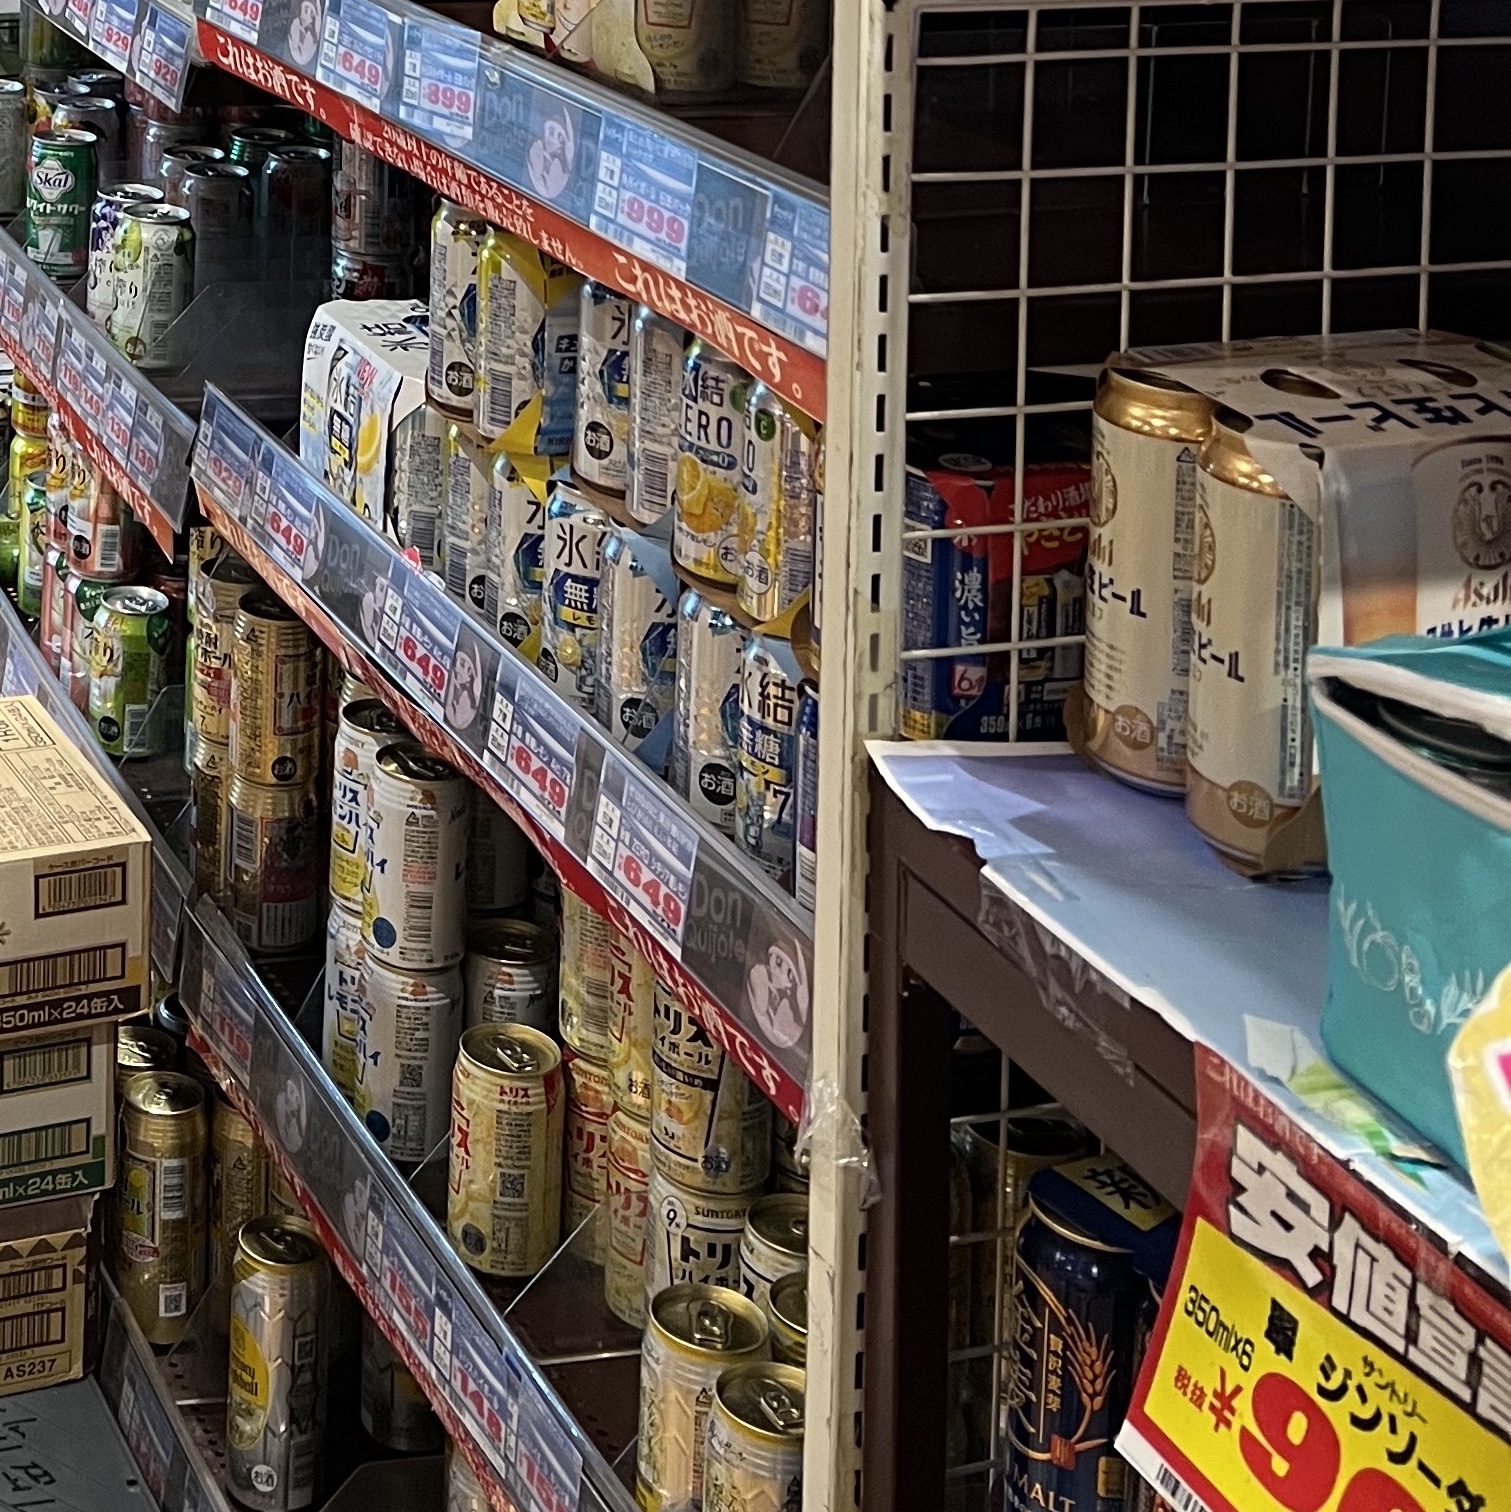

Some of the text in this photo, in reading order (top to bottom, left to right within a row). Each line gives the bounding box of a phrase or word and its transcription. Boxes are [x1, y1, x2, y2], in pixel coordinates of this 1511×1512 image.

[215, 32, 329, 119] これはお酒です。
[341, 50, 380, 85] 649
[428, 85, 472, 114] 899
[627, 201, 685, 244] 999
[612, 251, 805, 400] これはお酒です。
[556, 522, 588, 569] 氷
[403, 640, 445, 691] 649
[1113, 711, 1153, 743] お酒
[515, 745, 566, 810] 649
[700, 771, 735, 797] お酒
[1229, 795, 1270, 821] お酒
[624, 858, 682, 925] 649
[689, 875, 742, 922] Don
[499, 1086, 531, 1099] トリス
[3, 1359, 56, 1381] AS237
